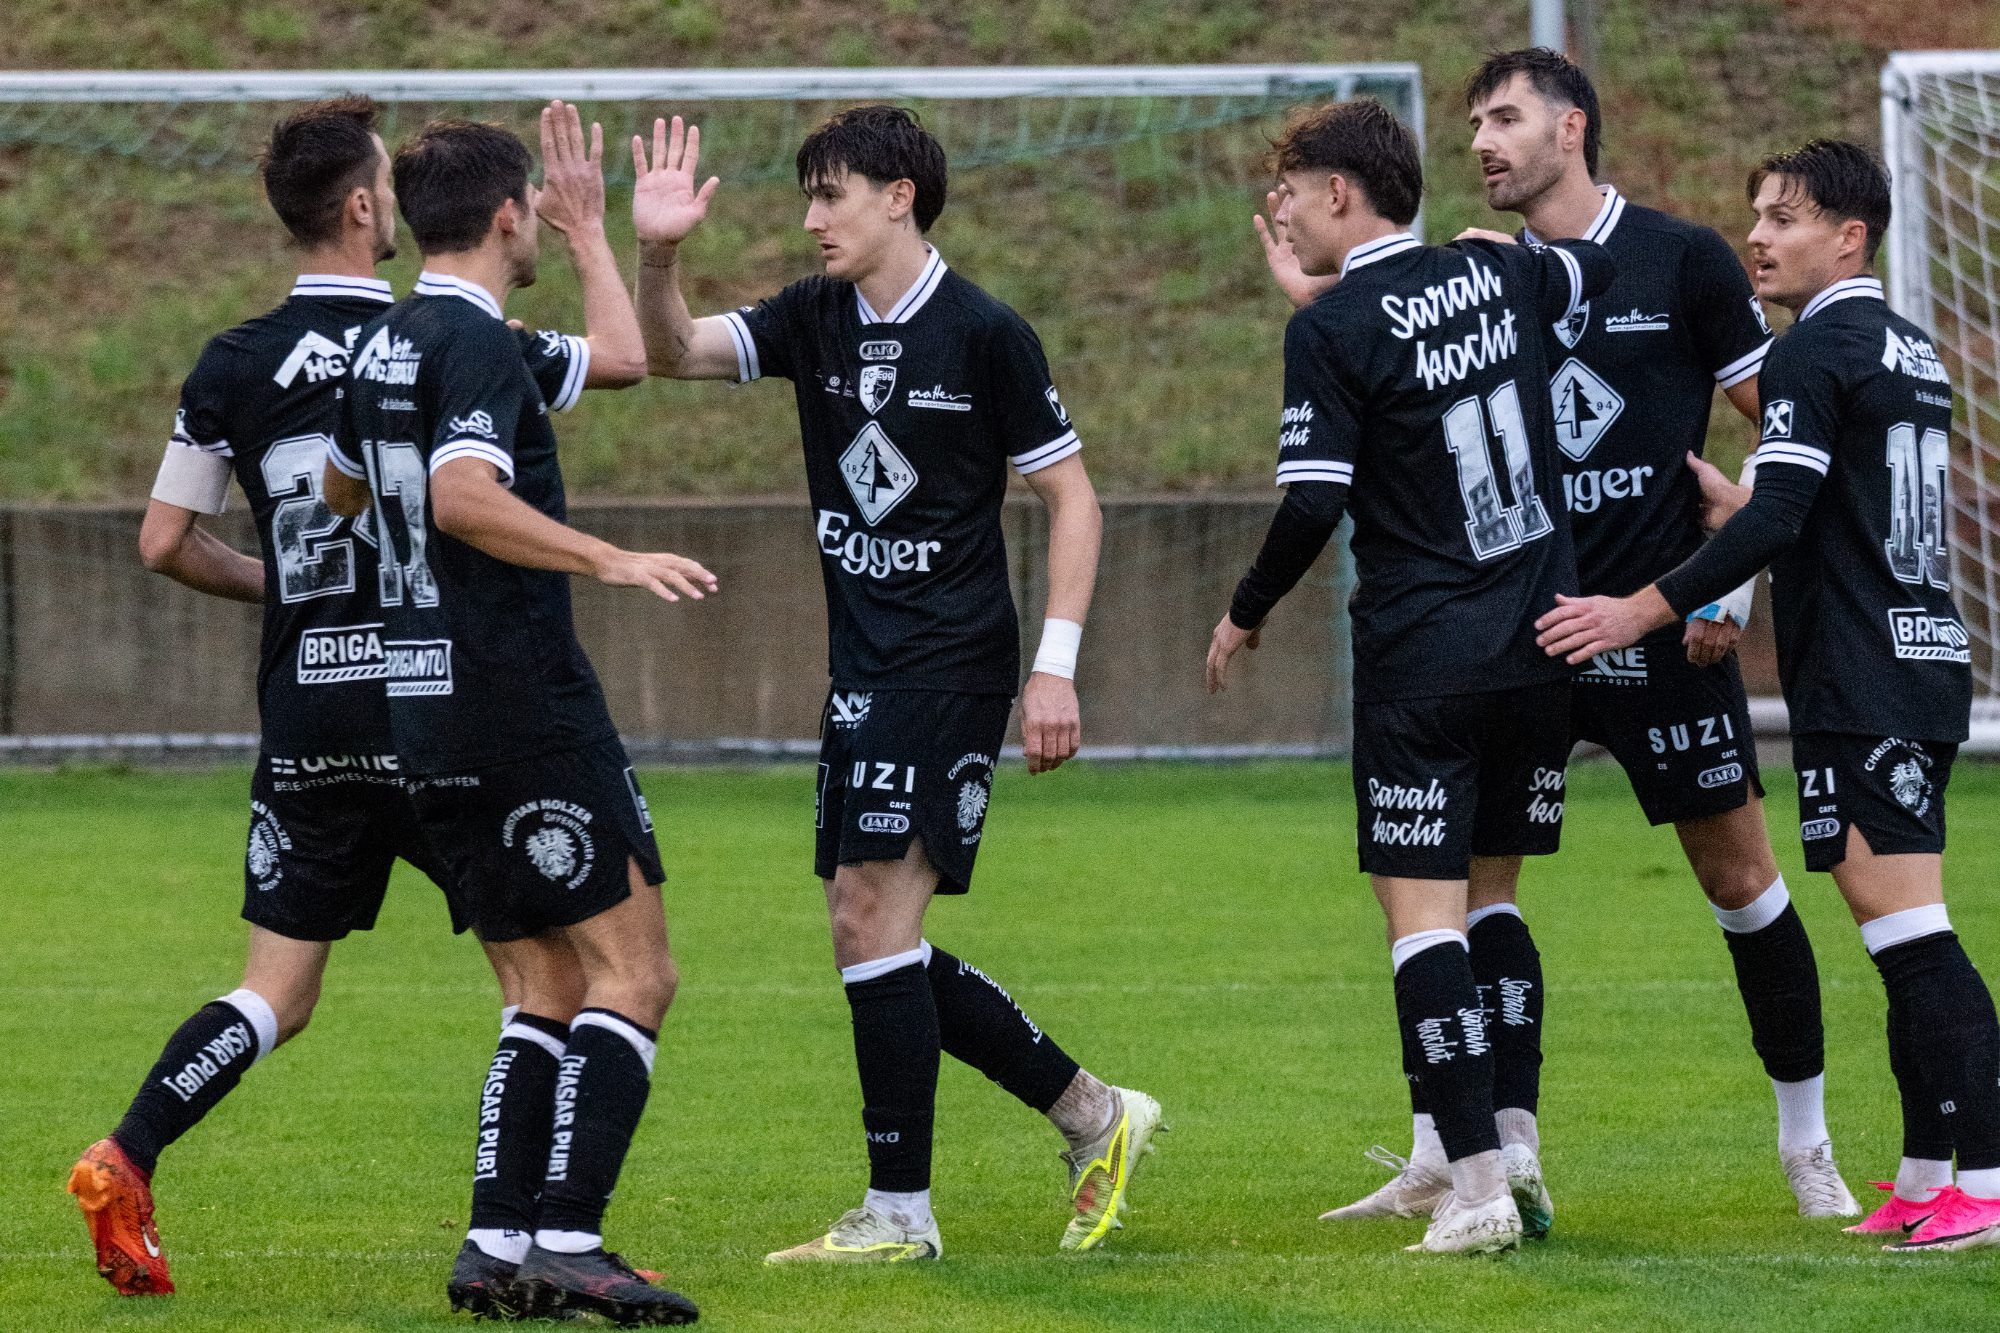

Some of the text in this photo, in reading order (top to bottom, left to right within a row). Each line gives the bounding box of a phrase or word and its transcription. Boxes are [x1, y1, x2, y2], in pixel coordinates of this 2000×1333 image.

[1381, 256, 1502, 340] Sarah
[864, 344, 898, 357] JAKO
[1416, 308, 1517, 391] kocht
[1442, 380, 1555, 561] 11
[817, 509, 942, 579] Egger
[1647, 713, 1734, 754] SUZI
[850, 761, 915, 793] UZI
[947, 752, 990, 780] CHRISTIAN
[889, 801, 911, 810] CAFE
[1368, 777, 1448, 811] Sarah
[540, 799, 593, 825] HOLZER
[863, 816, 905, 830] JAKO
[1371, 811, 1447, 847] kocht
